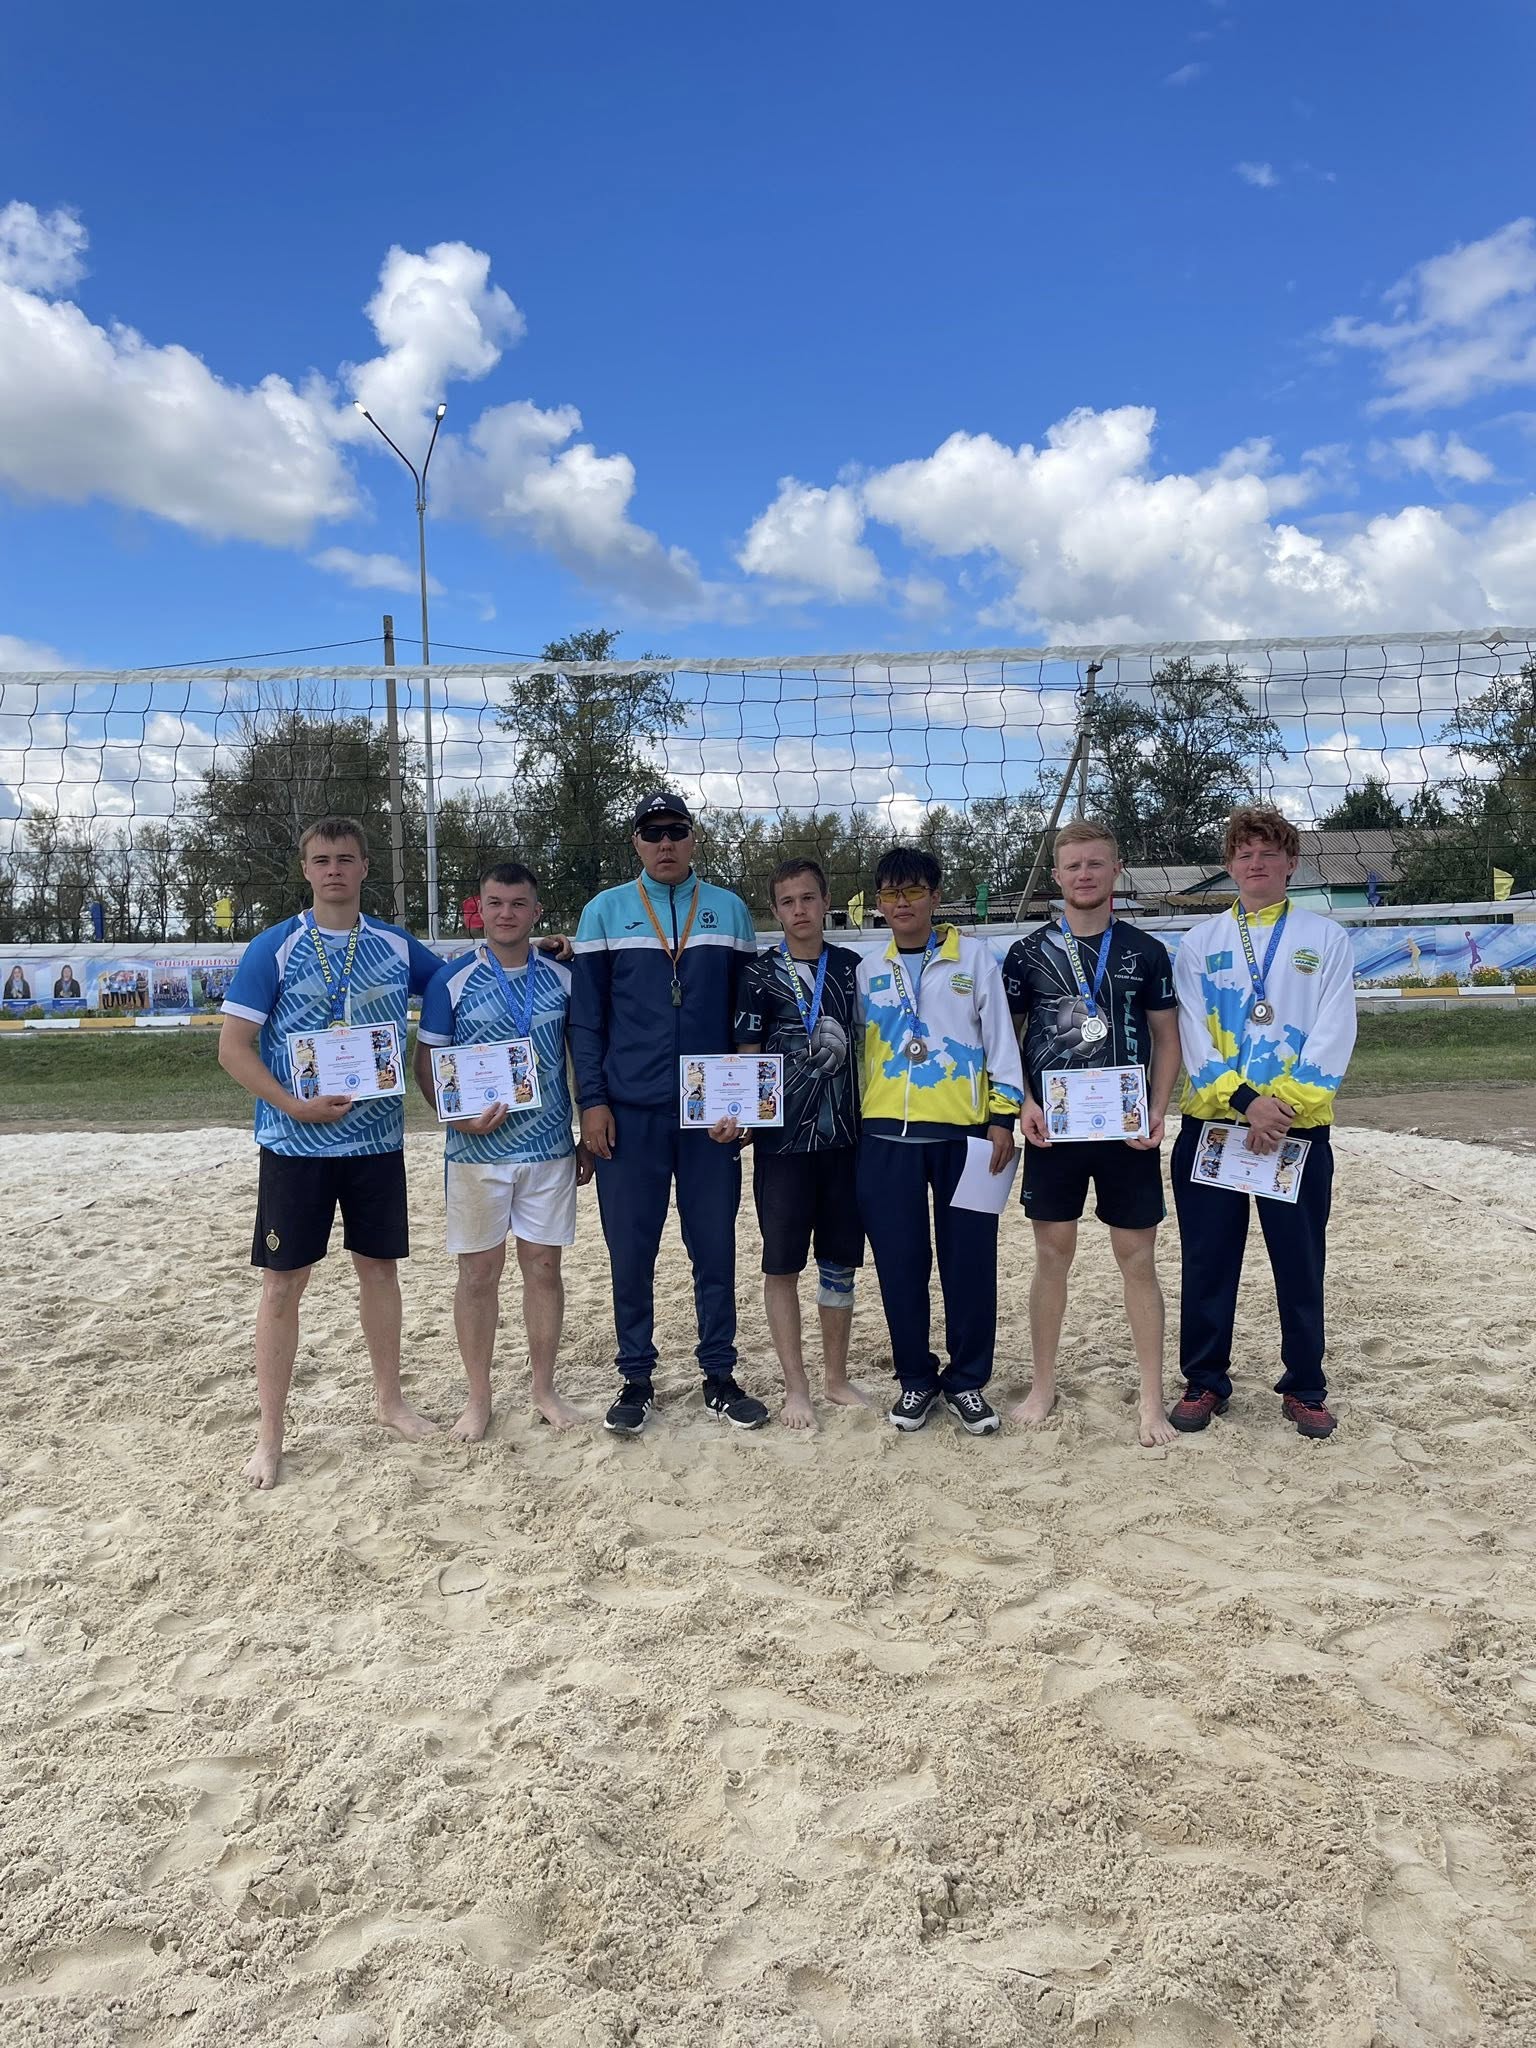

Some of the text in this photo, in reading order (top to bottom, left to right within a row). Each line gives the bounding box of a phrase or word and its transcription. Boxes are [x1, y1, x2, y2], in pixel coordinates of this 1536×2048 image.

[310, 928, 333, 983] QAZAQSTAN
[1064, 932, 1087, 983] QAZAQSTAN
[1237, 913, 1256, 965] QAZAQSTAN
[782, 951, 804, 999] QAZAQSTAN
